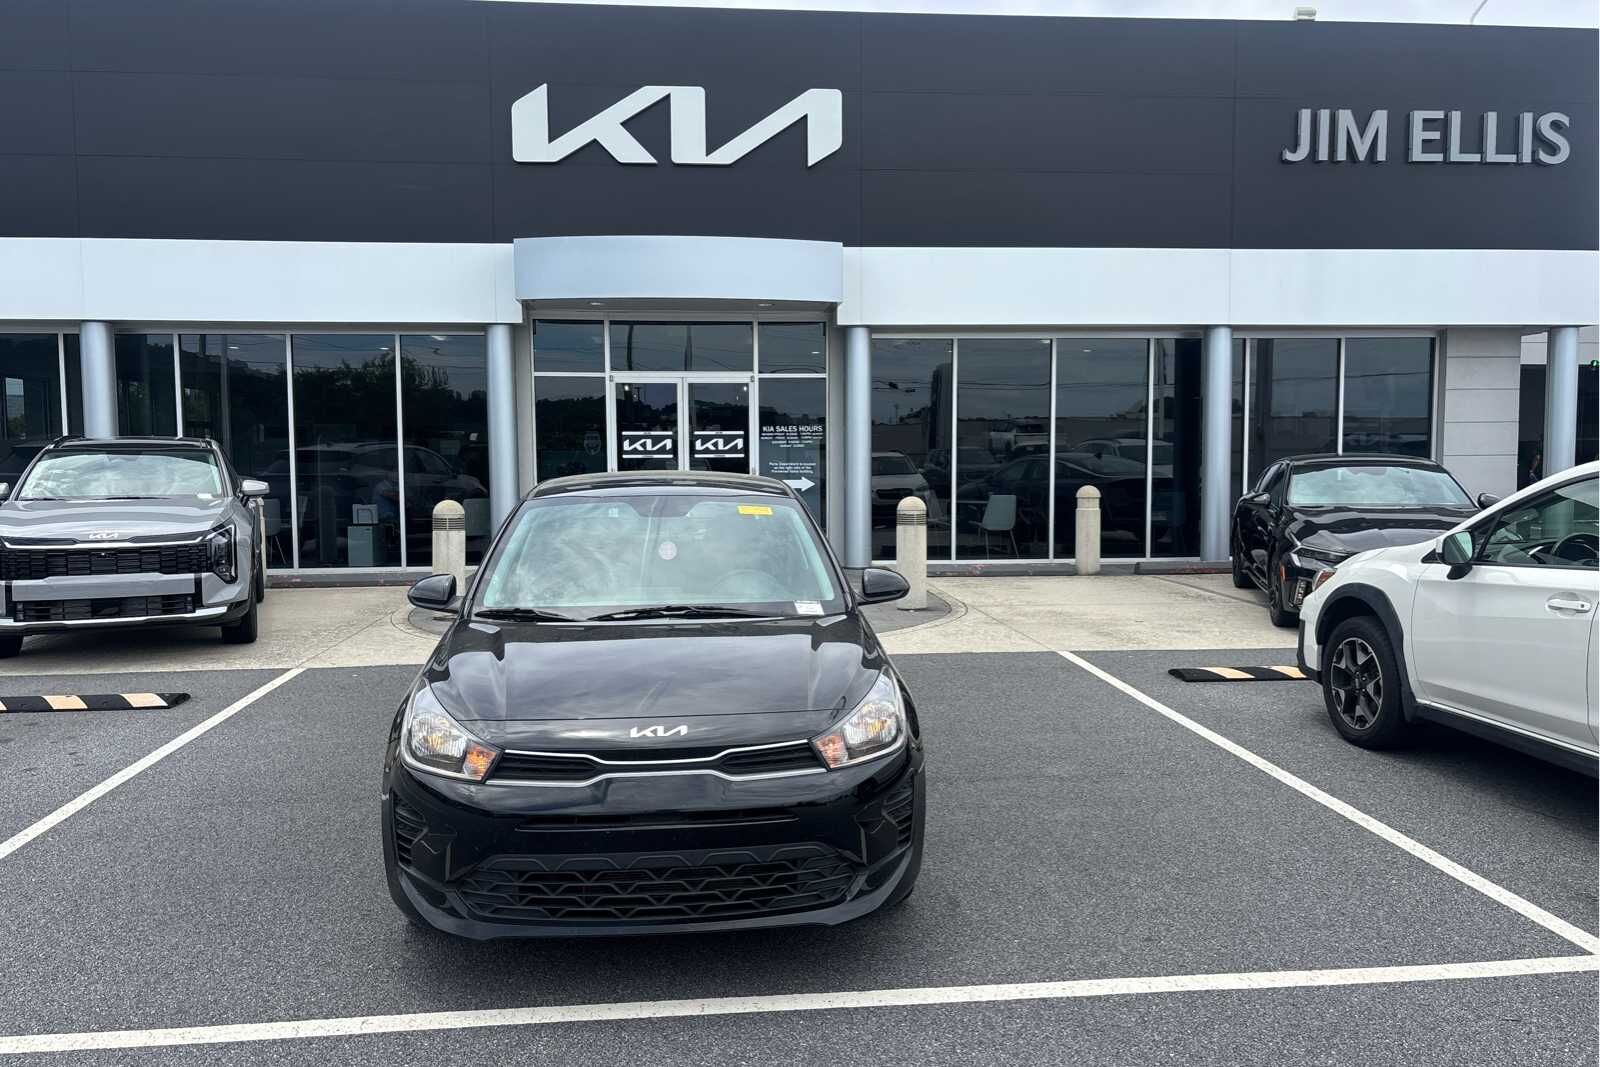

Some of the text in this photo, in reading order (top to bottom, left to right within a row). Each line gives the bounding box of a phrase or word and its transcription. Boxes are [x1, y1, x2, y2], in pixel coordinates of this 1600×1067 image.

[511, 83, 843, 168] KIA
[1282, 108, 1571, 165] JIM ELLIS
[798, 424, 823, 432] HOURS
[623, 438, 673, 451] KIA
[695, 438, 744, 450] KIA
[630, 725, 688, 738] KIA
